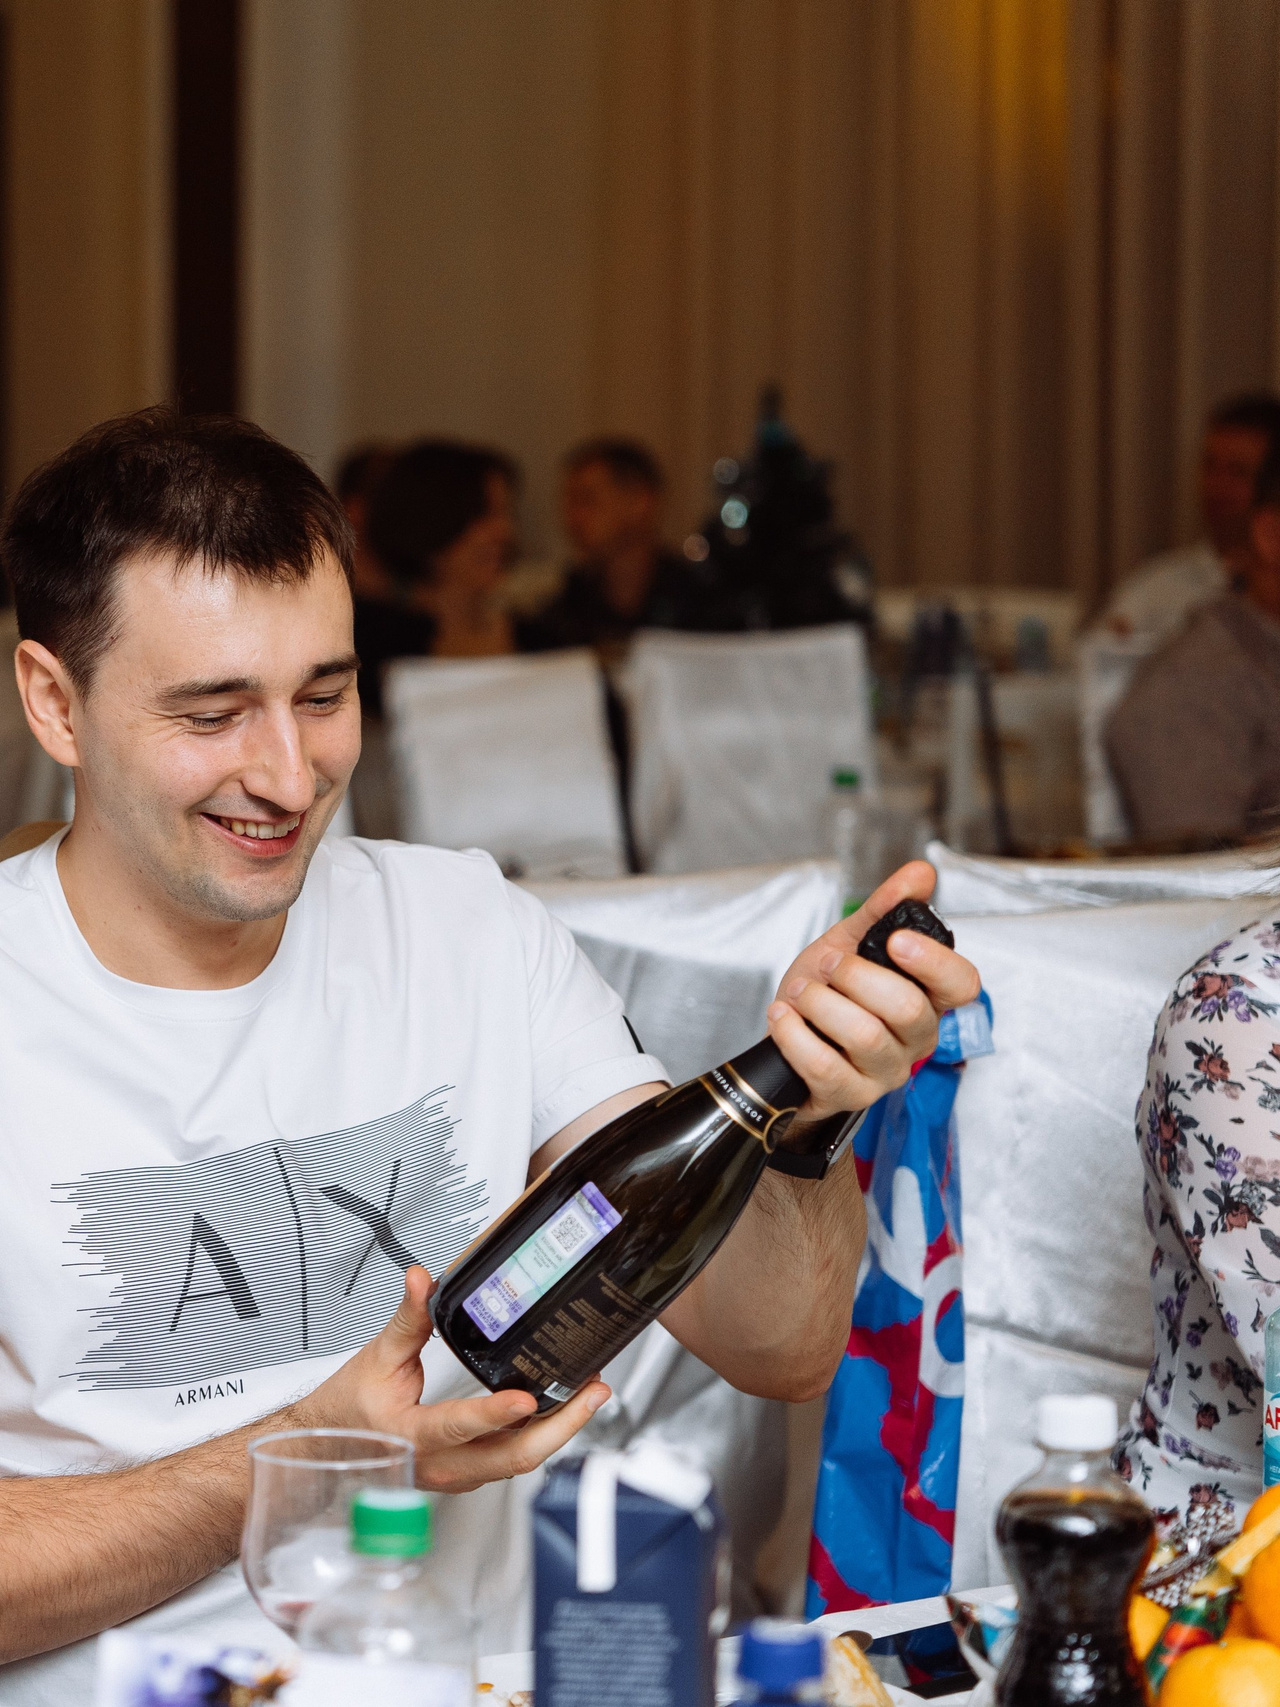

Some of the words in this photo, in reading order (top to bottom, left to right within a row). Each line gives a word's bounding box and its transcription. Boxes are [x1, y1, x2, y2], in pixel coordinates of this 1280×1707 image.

[489, 1278, 519, 1314] ФЕДЕРАЛЬНАЯ
[493, 1275, 523, 1311] СПЕЦИАЛЬНАЯ
[503, 1280, 518, 1298] МАРКА
[469, 1299, 497, 1333] РОССИЙСКАЯ
[472, 1296, 500, 1329] ФЕДЕРАЦИЯ
[174, 1378, 245, 1408] ARMANI
